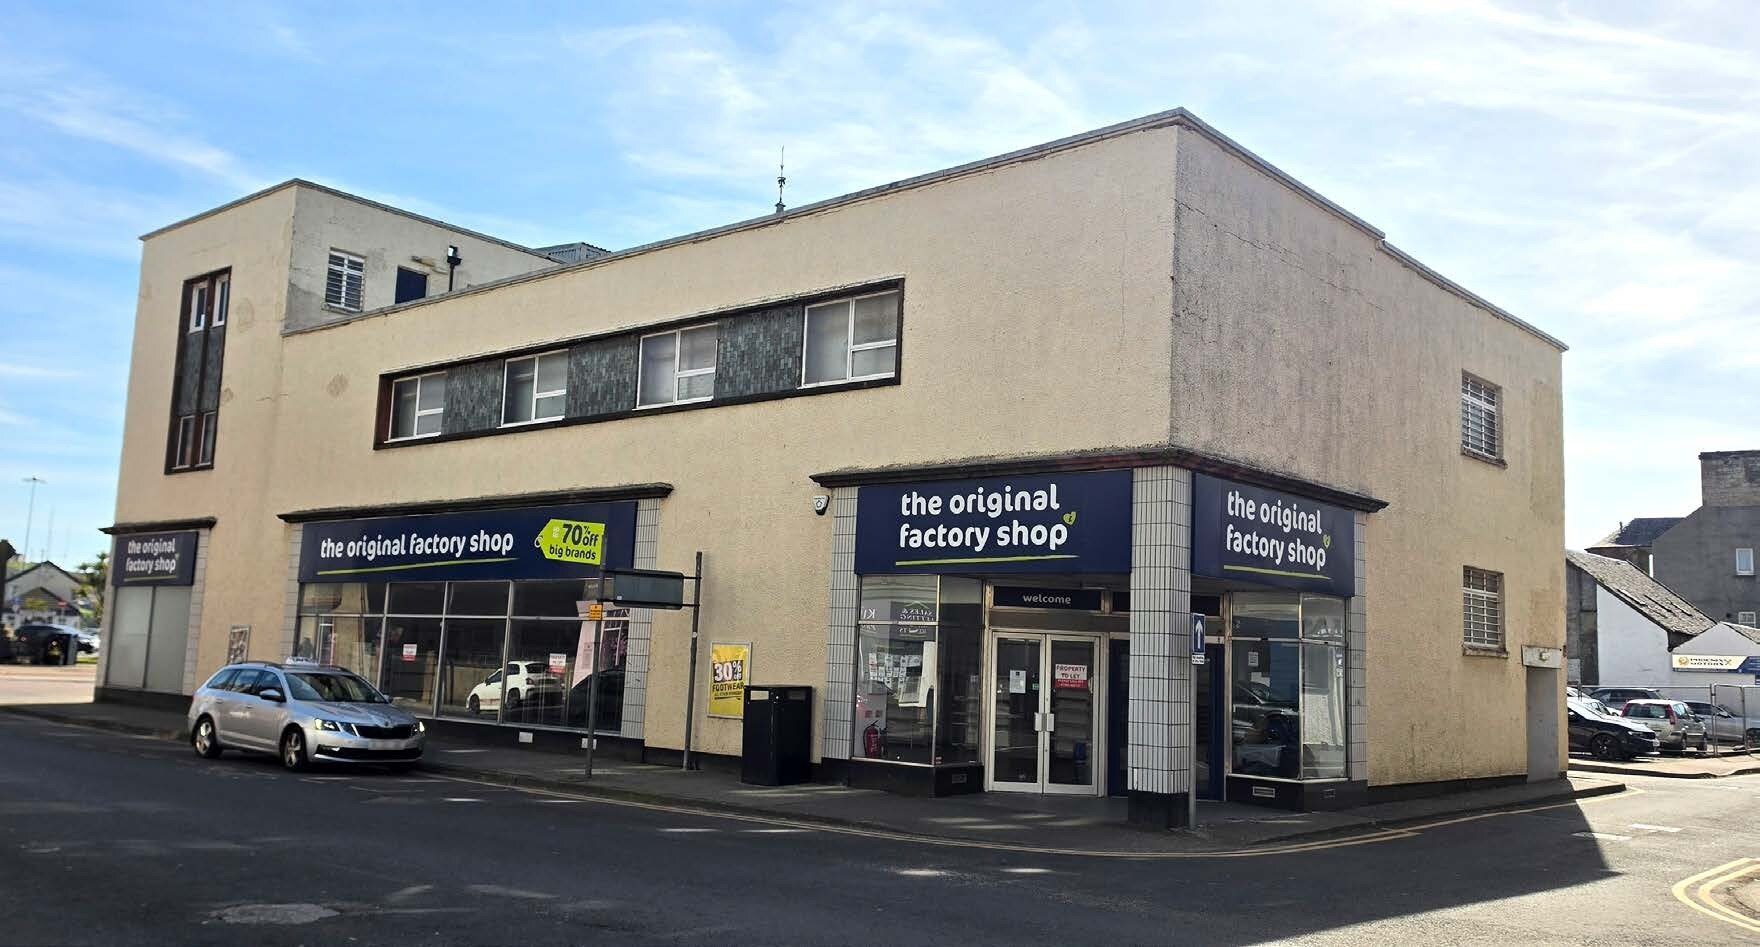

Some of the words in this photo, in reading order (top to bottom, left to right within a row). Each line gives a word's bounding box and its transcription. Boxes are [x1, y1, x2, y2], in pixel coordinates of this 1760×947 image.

[901, 491, 943, 516] the
[949, 483, 1060, 518] original
[1227, 490, 1256, 520] the
[1260, 499, 1322, 535] original
[320, 538, 344, 558] the
[346, 533, 406, 561] original
[409, 533, 467, 558] factory
[469, 529, 514, 556] shop
[562, 523, 591, 545] 70%
[582, 533, 599, 546] off
[899, 523, 990, 552] factory
[996, 519, 1068, 550] shop
[127, 540, 142, 554] the
[142, 538, 176, 556] original
[549, 544, 564, 558] big
[565, 546, 597, 560] brands
[1226, 523, 1284, 565] factory
[1287, 538, 1326, 571] shop
[125, 557, 154, 574] factory
[154, 556, 176, 574] shop
[1022, 594, 1072, 605] welcome
[714, 661, 742, 682] 30%
[1056, 665, 1086, 673] PROPERTY
[712, 682, 745, 692] FOOTWEAR
